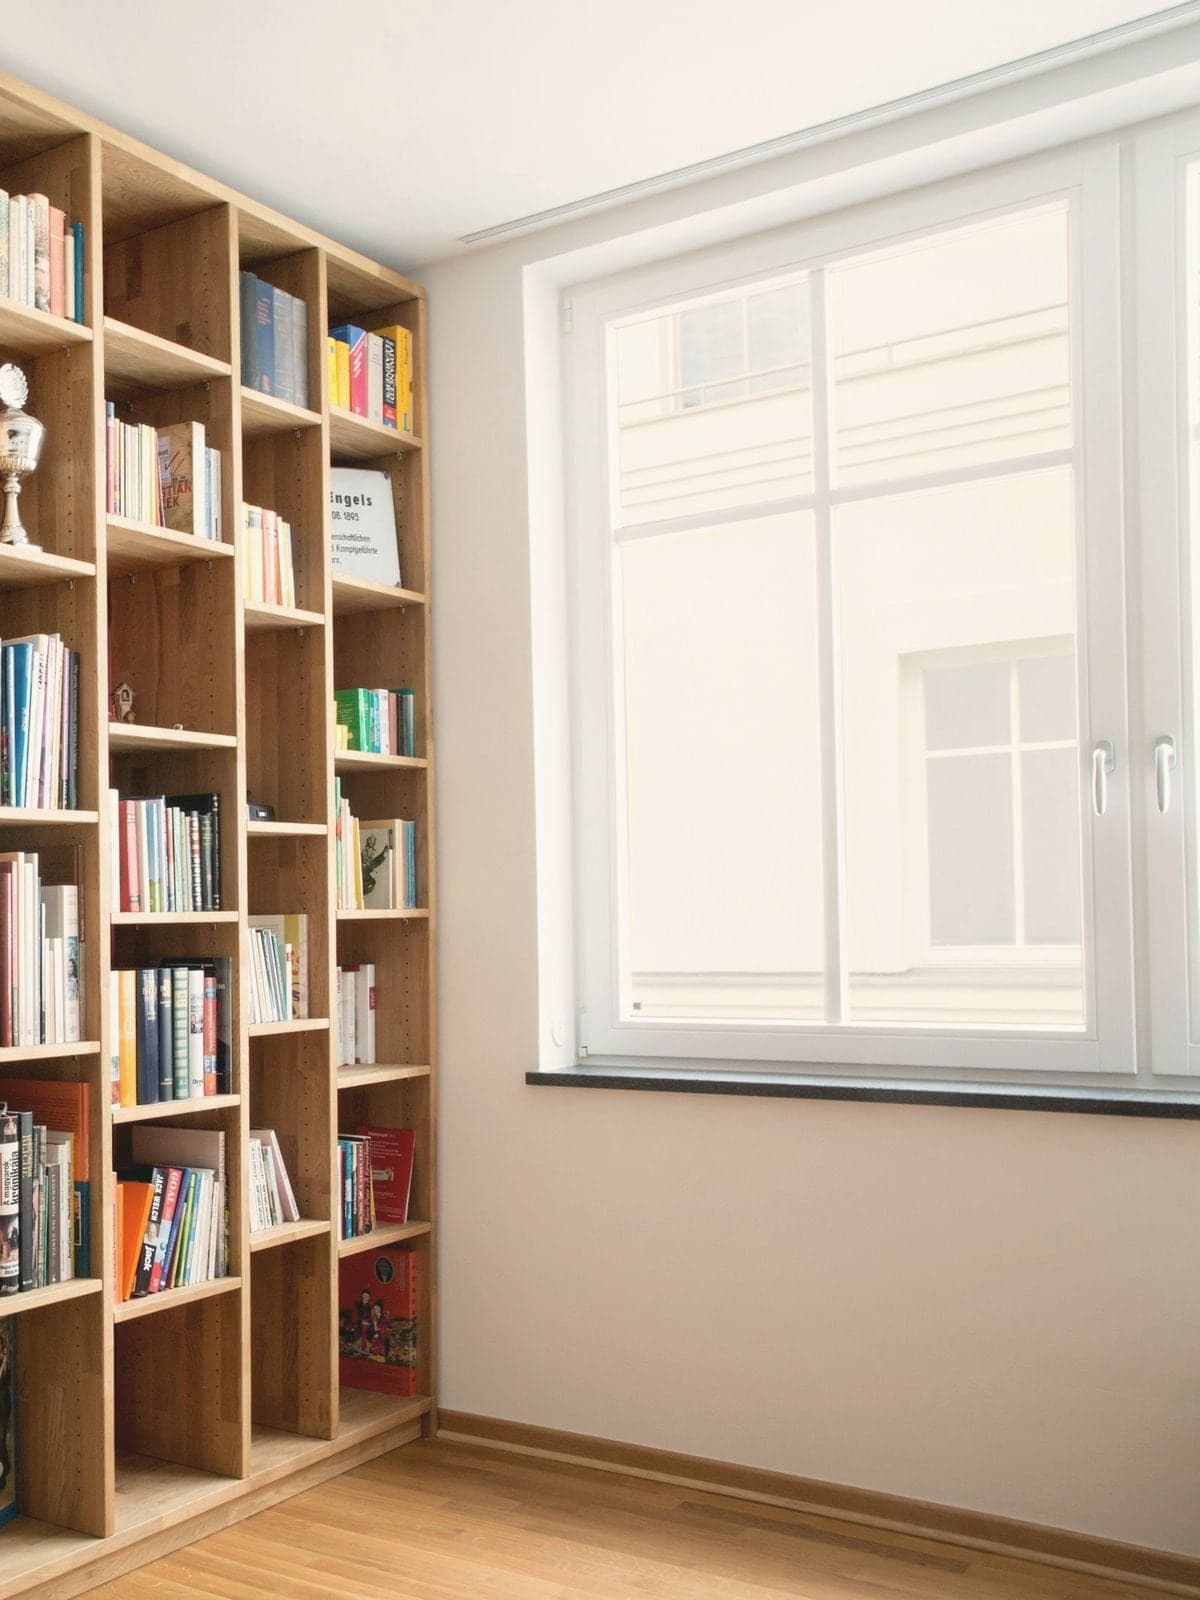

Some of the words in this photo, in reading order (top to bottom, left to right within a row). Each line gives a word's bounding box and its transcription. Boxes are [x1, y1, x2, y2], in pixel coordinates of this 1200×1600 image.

[3, 1162, 12, 1198] magyarok
[10, 1151, 19, 1205] krónikája
[154, 1174, 164, 1194] JACK
[167, 1171, 179, 1206] GOAL
[150, 1196, 161, 1222] WELCH
